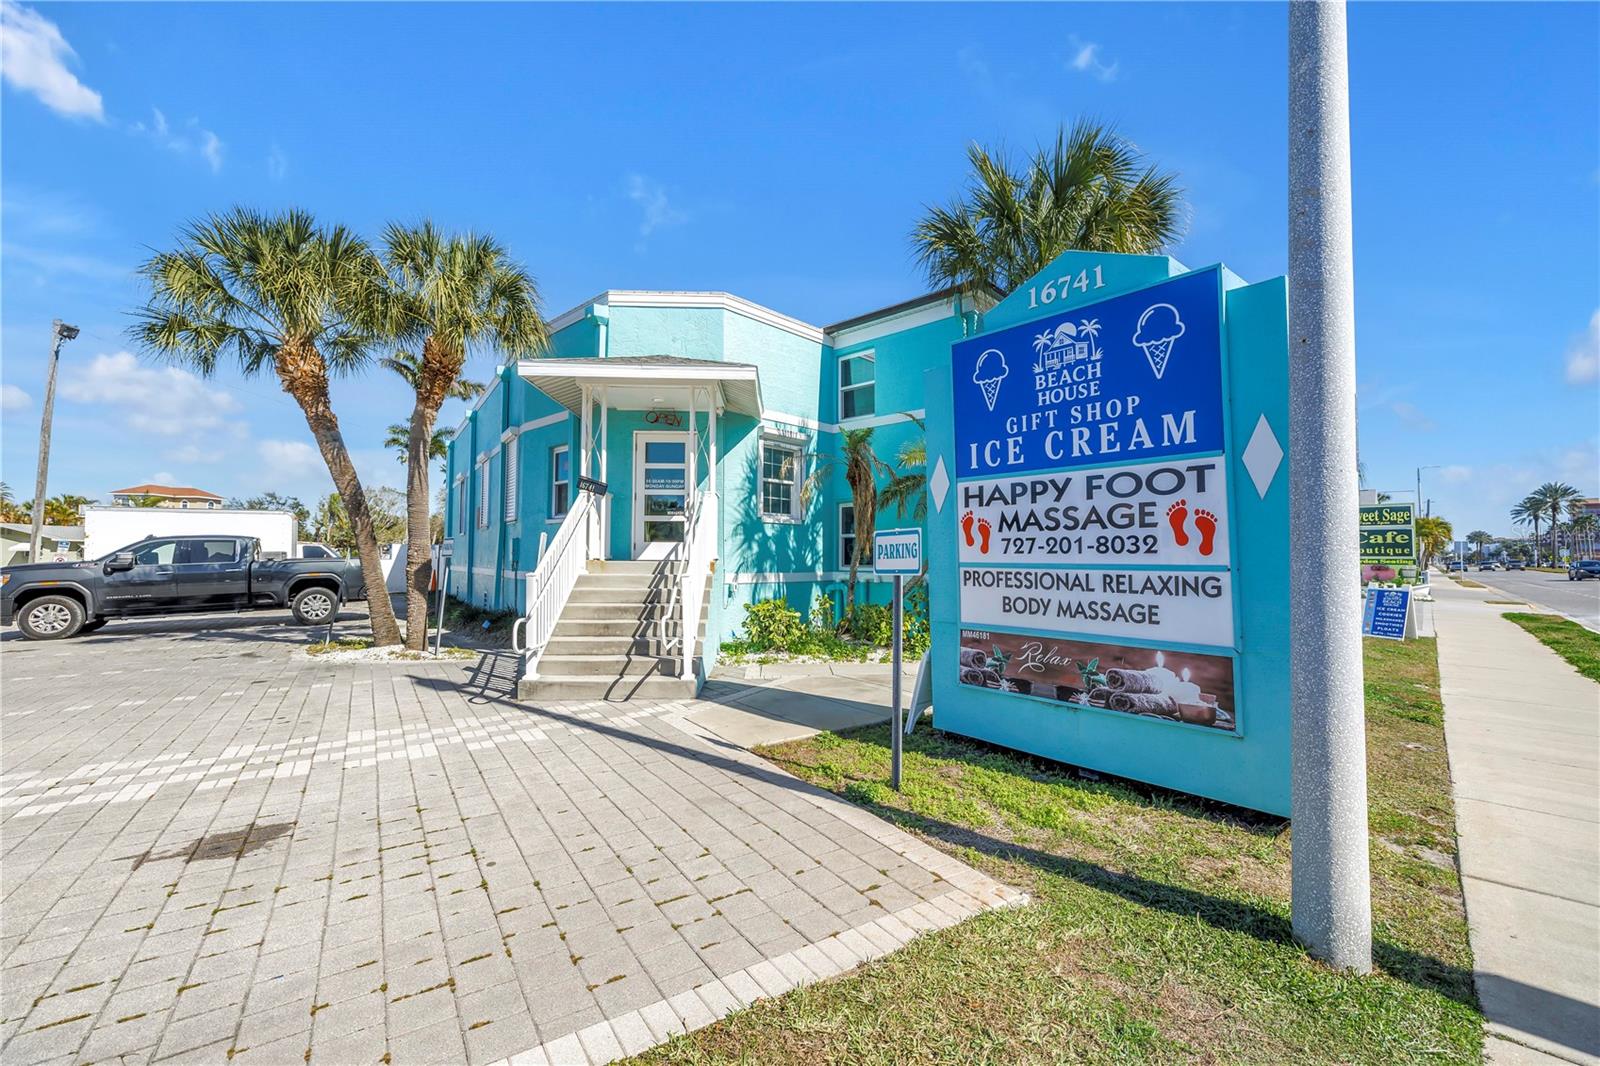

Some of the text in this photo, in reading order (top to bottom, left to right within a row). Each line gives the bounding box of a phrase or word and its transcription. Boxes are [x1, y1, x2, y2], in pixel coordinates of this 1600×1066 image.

[1028, 264, 1106, 309] 16741
[1035, 361, 1102, 390] BEACH
[1037, 381, 1101, 407] HOUSE
[646, 411, 682, 426] OPEN
[1006, 395, 1140, 434] GIFT SHOP
[970, 410, 1197, 469] ICE CREAM
[964, 464, 1216, 508] HAPPY FOOT
[997, 501, 1159, 533] MASSAGE
[1360, 508, 1410, 524] eet Sage
[878, 542, 918, 560] PARKING
[1001, 535, 1159, 555] 727-201-8032
[1360, 546, 1410, 556] outique
[963, 570, 1223, 598] PROFESSIONAL RELAXING
[1002, 596, 1160, 626] BODY MASSAGE
[1016, 640, 1073, 673] Relax
